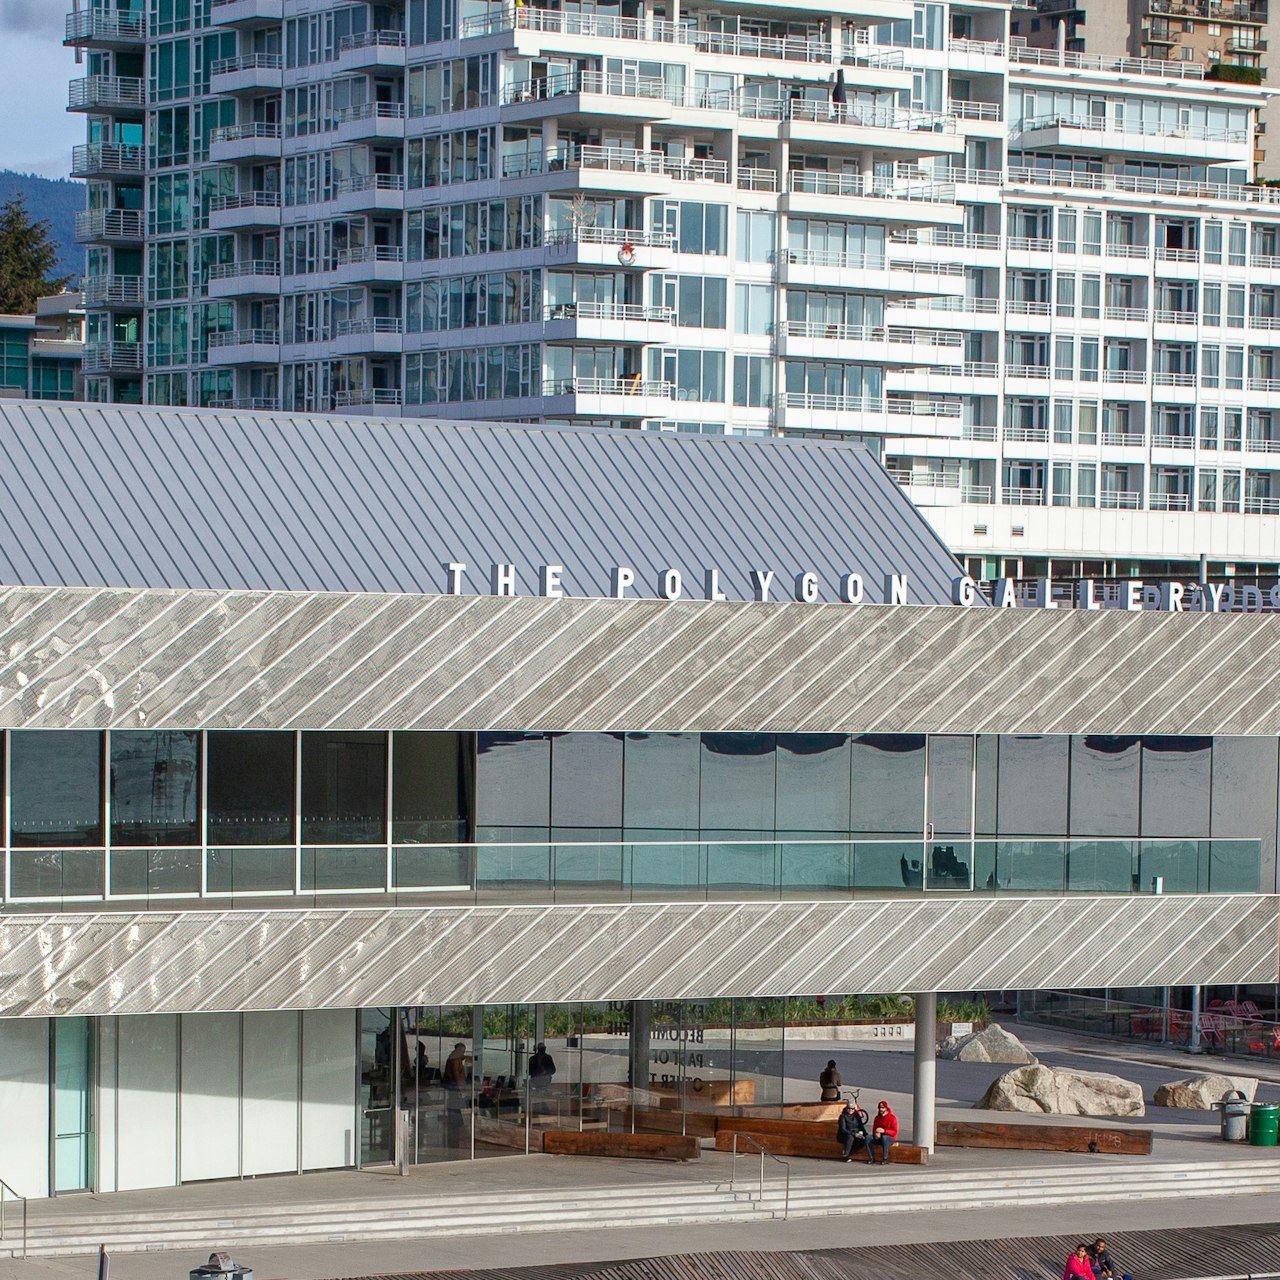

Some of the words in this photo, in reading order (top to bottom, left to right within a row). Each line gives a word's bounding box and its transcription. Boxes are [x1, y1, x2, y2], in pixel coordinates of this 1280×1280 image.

[445, 562, 564, 598] THE
[612, 566, 908, 605] POLYGON
[955, 575, 1225, 613] GALLERY
